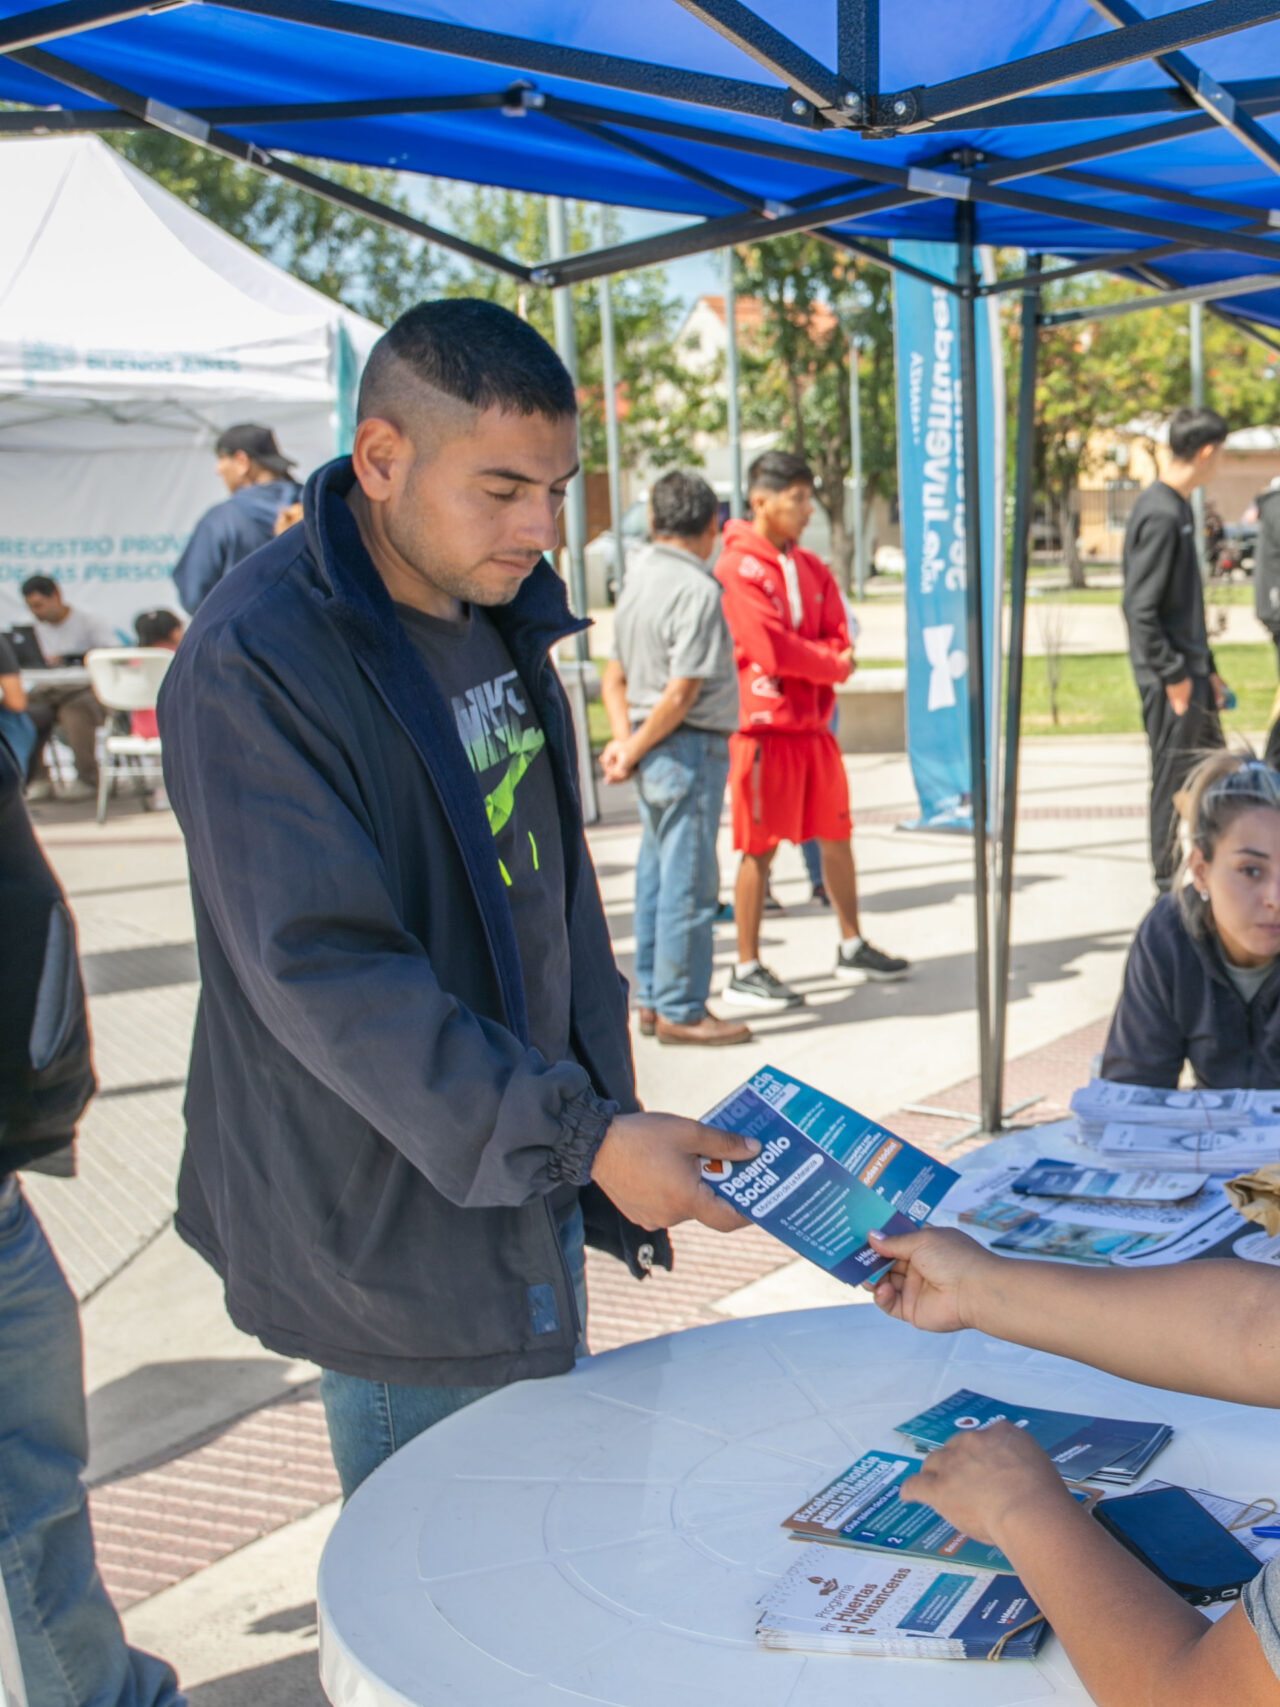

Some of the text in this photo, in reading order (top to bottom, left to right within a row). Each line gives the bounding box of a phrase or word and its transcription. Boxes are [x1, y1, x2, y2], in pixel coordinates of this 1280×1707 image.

[451, 669, 527, 773] NIKE
[718, 1136, 791, 1198] Desarrollo
[734, 1168, 780, 1207] Social
[755, 1189, 785, 1214] Municipio
[842, 1456, 880, 1483] noticia
[811, 1500, 840, 1524] para
[815, 1584, 855, 1619] Programa
[832, 1583, 878, 1621] Huertas
[850, 1567, 911, 1625] Matanceras
